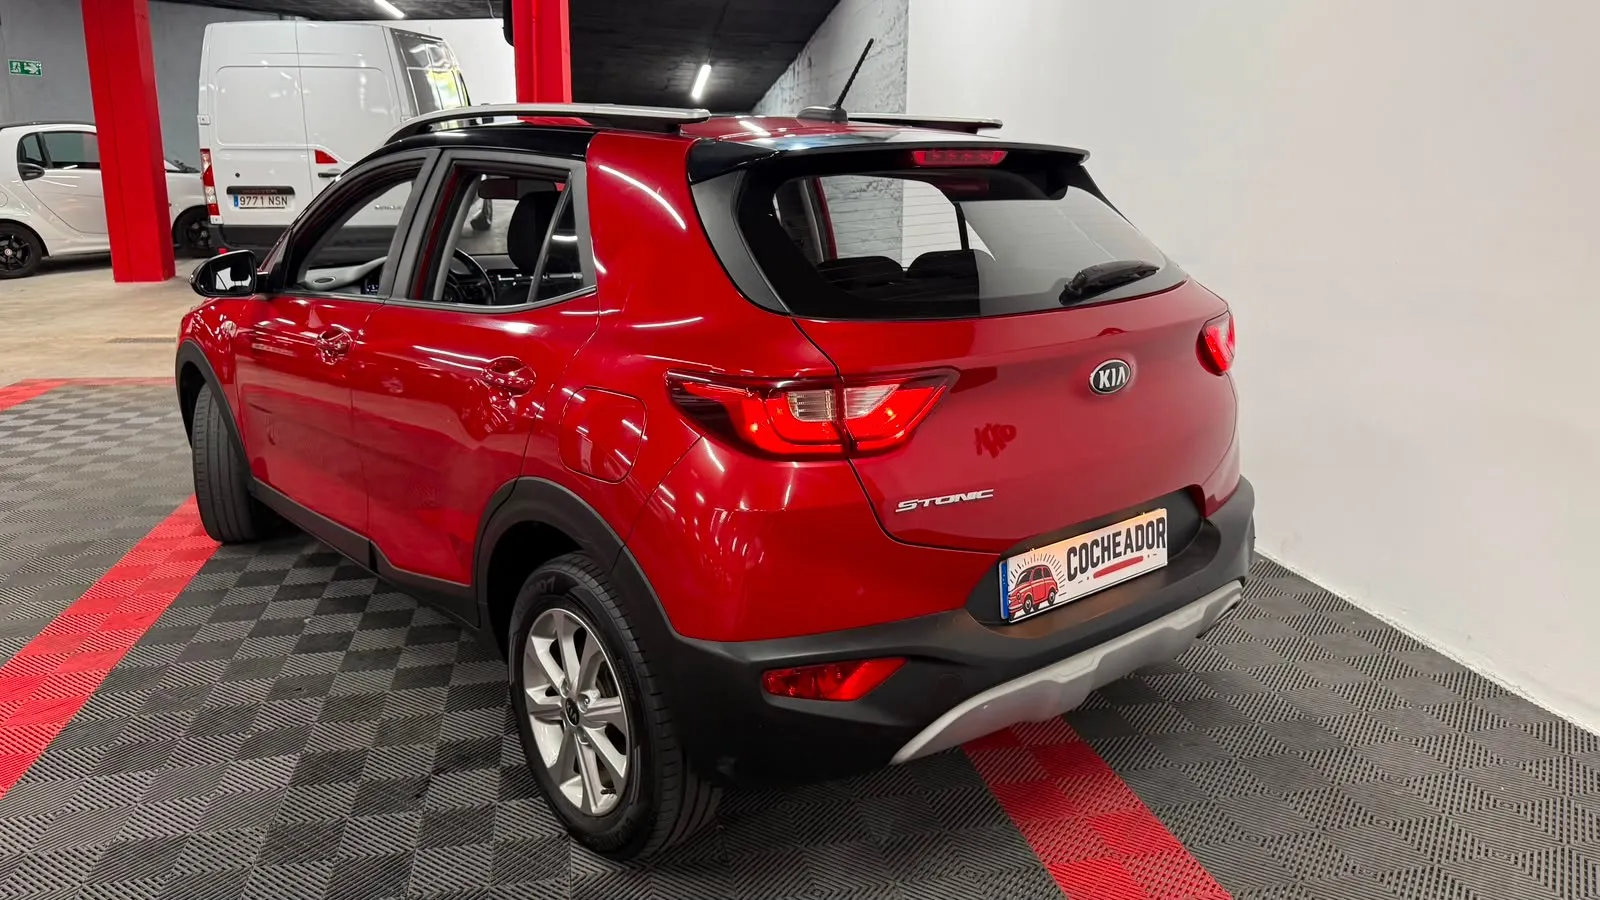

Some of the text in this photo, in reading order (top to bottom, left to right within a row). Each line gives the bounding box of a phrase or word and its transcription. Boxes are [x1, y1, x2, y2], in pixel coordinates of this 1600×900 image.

[239, 195, 288, 206] 9771 NSN
[1098, 366, 1126, 389] KIA
[895, 489, 994, 513] STONIC
[1066, 516, 1166, 582] COCHEADOR
